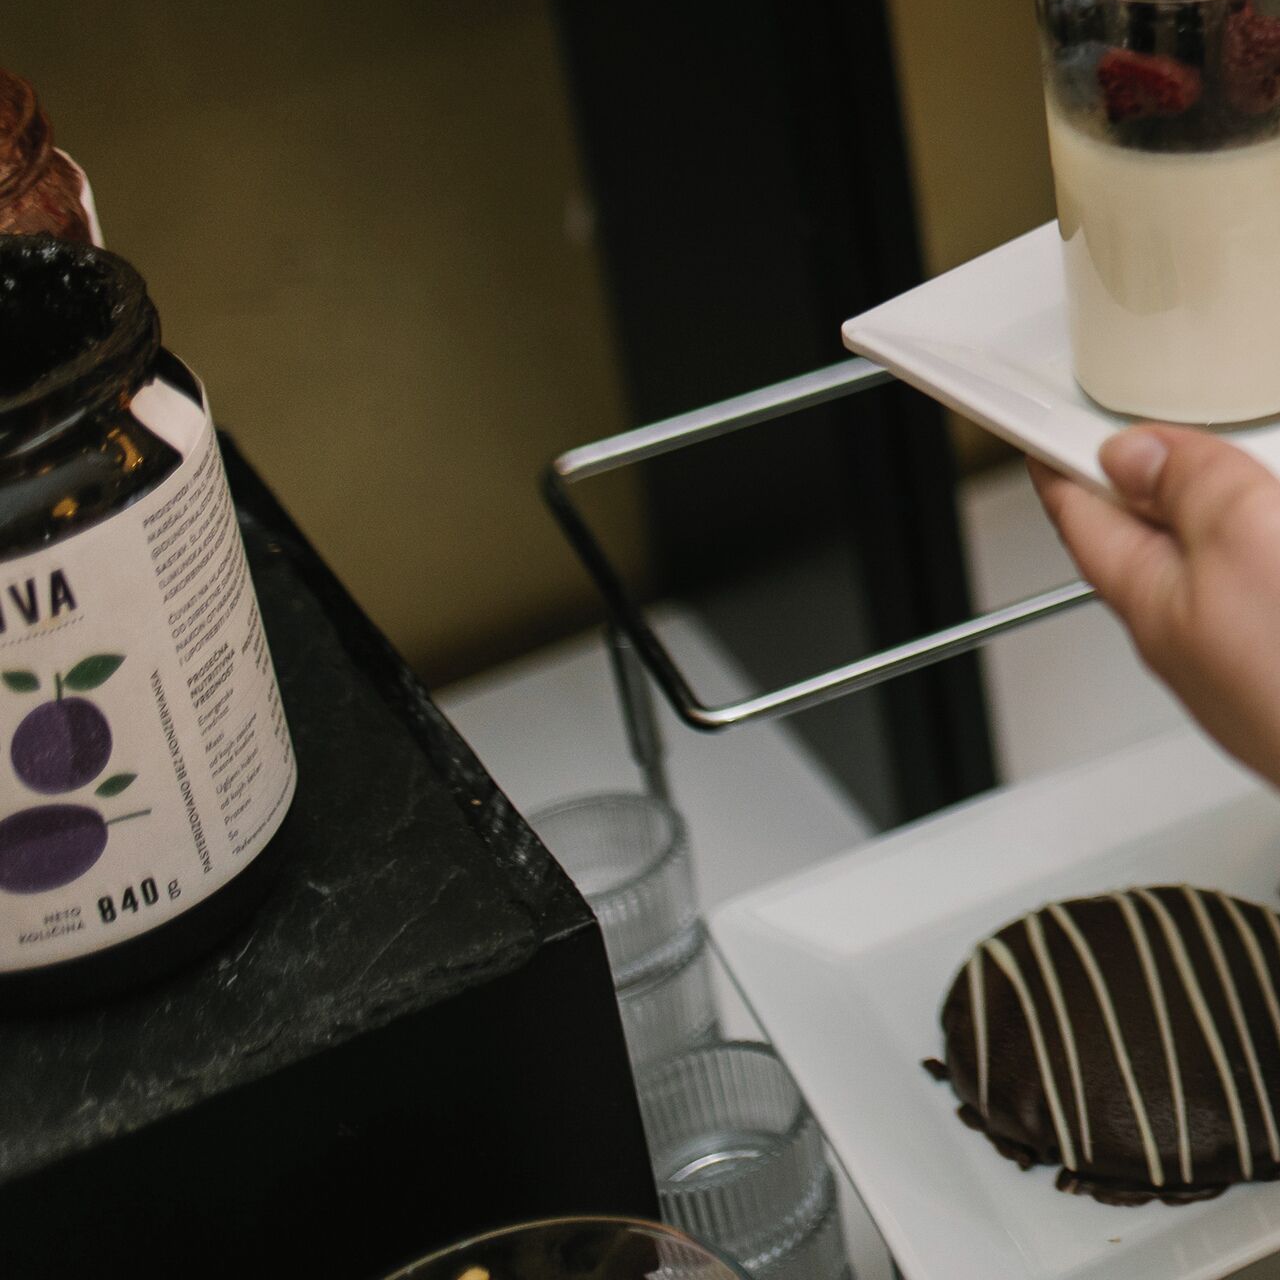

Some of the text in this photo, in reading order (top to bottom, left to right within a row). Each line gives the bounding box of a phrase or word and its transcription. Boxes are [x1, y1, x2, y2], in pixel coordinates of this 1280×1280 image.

[172, 756, 188, 781] BEZ
[180, 780, 213, 874] PASTERIZOVANO
[97, 876, 182, 924] 840 g
